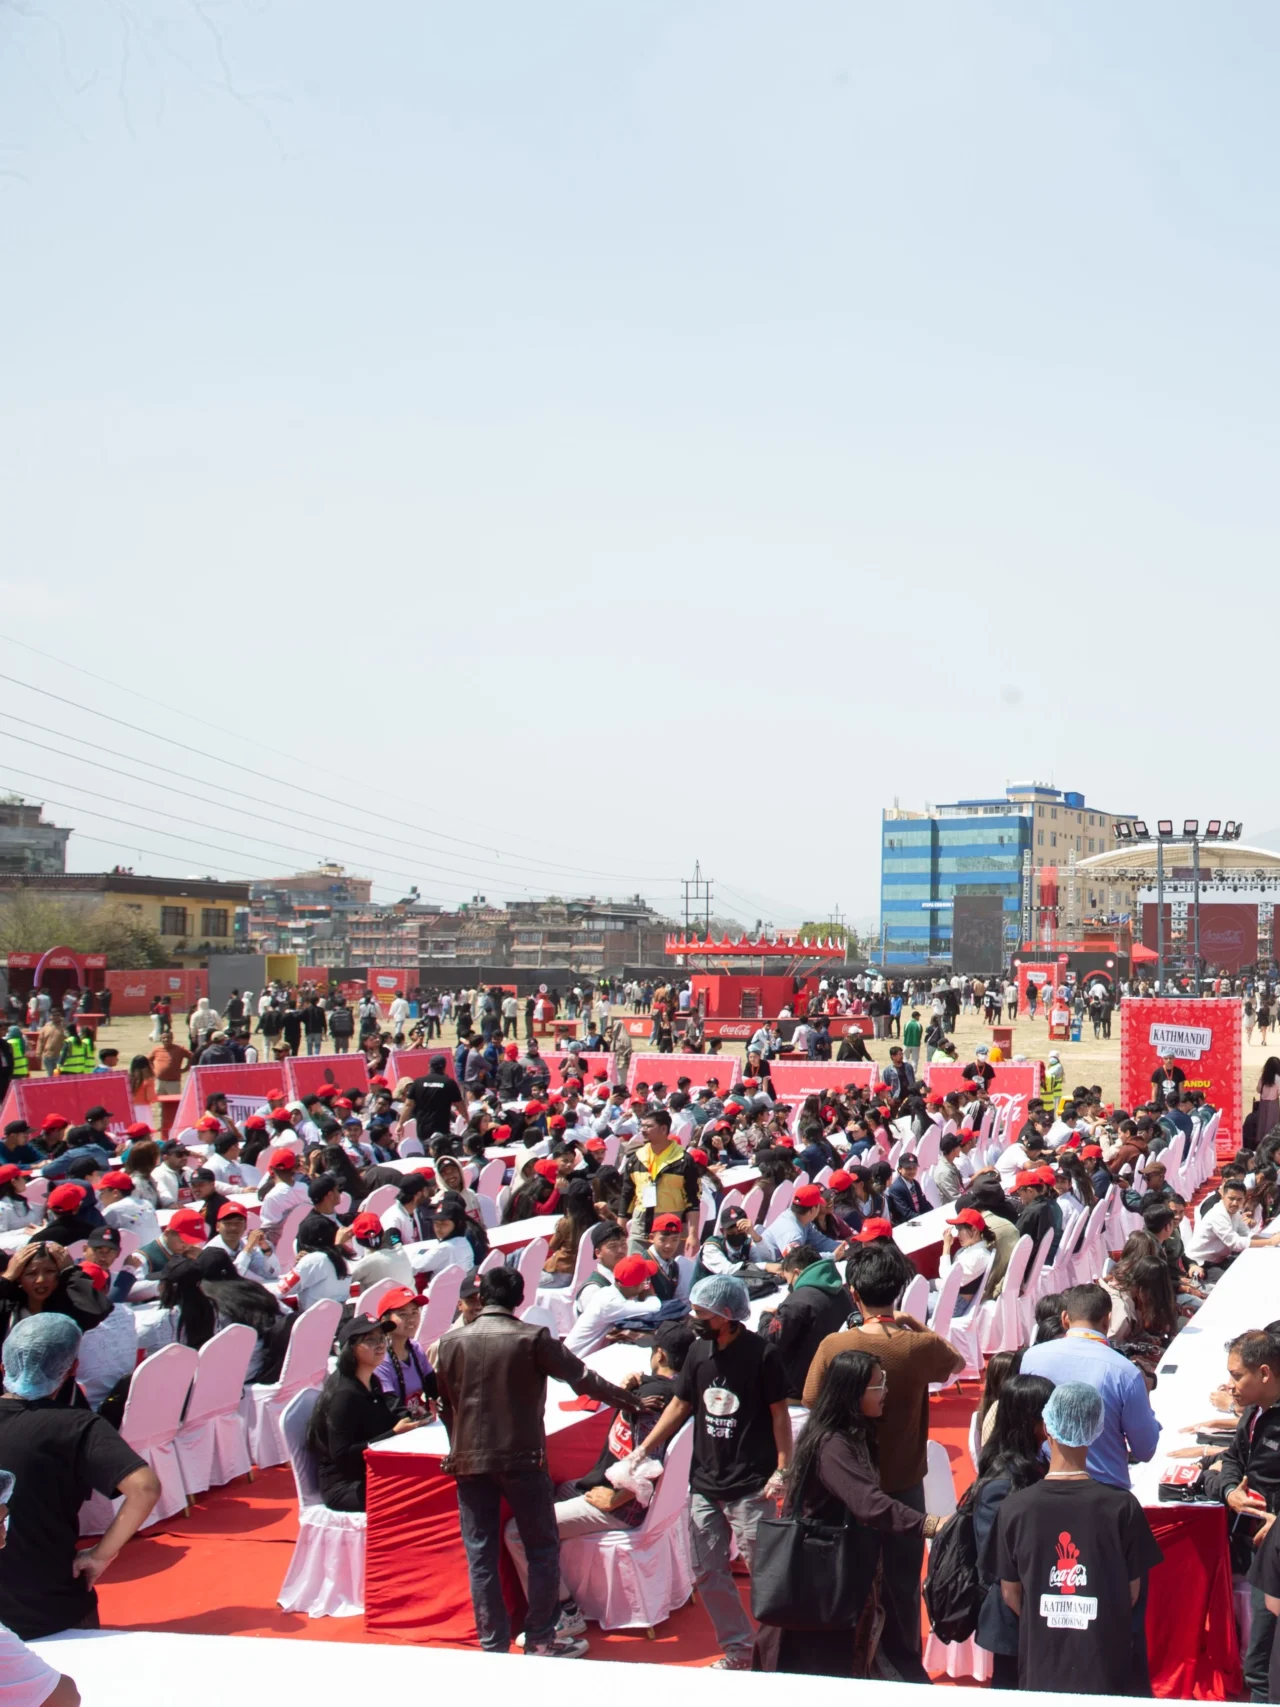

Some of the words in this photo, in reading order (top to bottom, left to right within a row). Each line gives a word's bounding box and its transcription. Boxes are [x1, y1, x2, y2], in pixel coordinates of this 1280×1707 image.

[1153, 1029, 1208, 1046] KATHMANDU
[1049, 1564, 1087, 1587] Coca-Cola
[1043, 1600, 1094, 1615] KATHMANDU
[1058, 1617, 1084, 1627] COOKING
